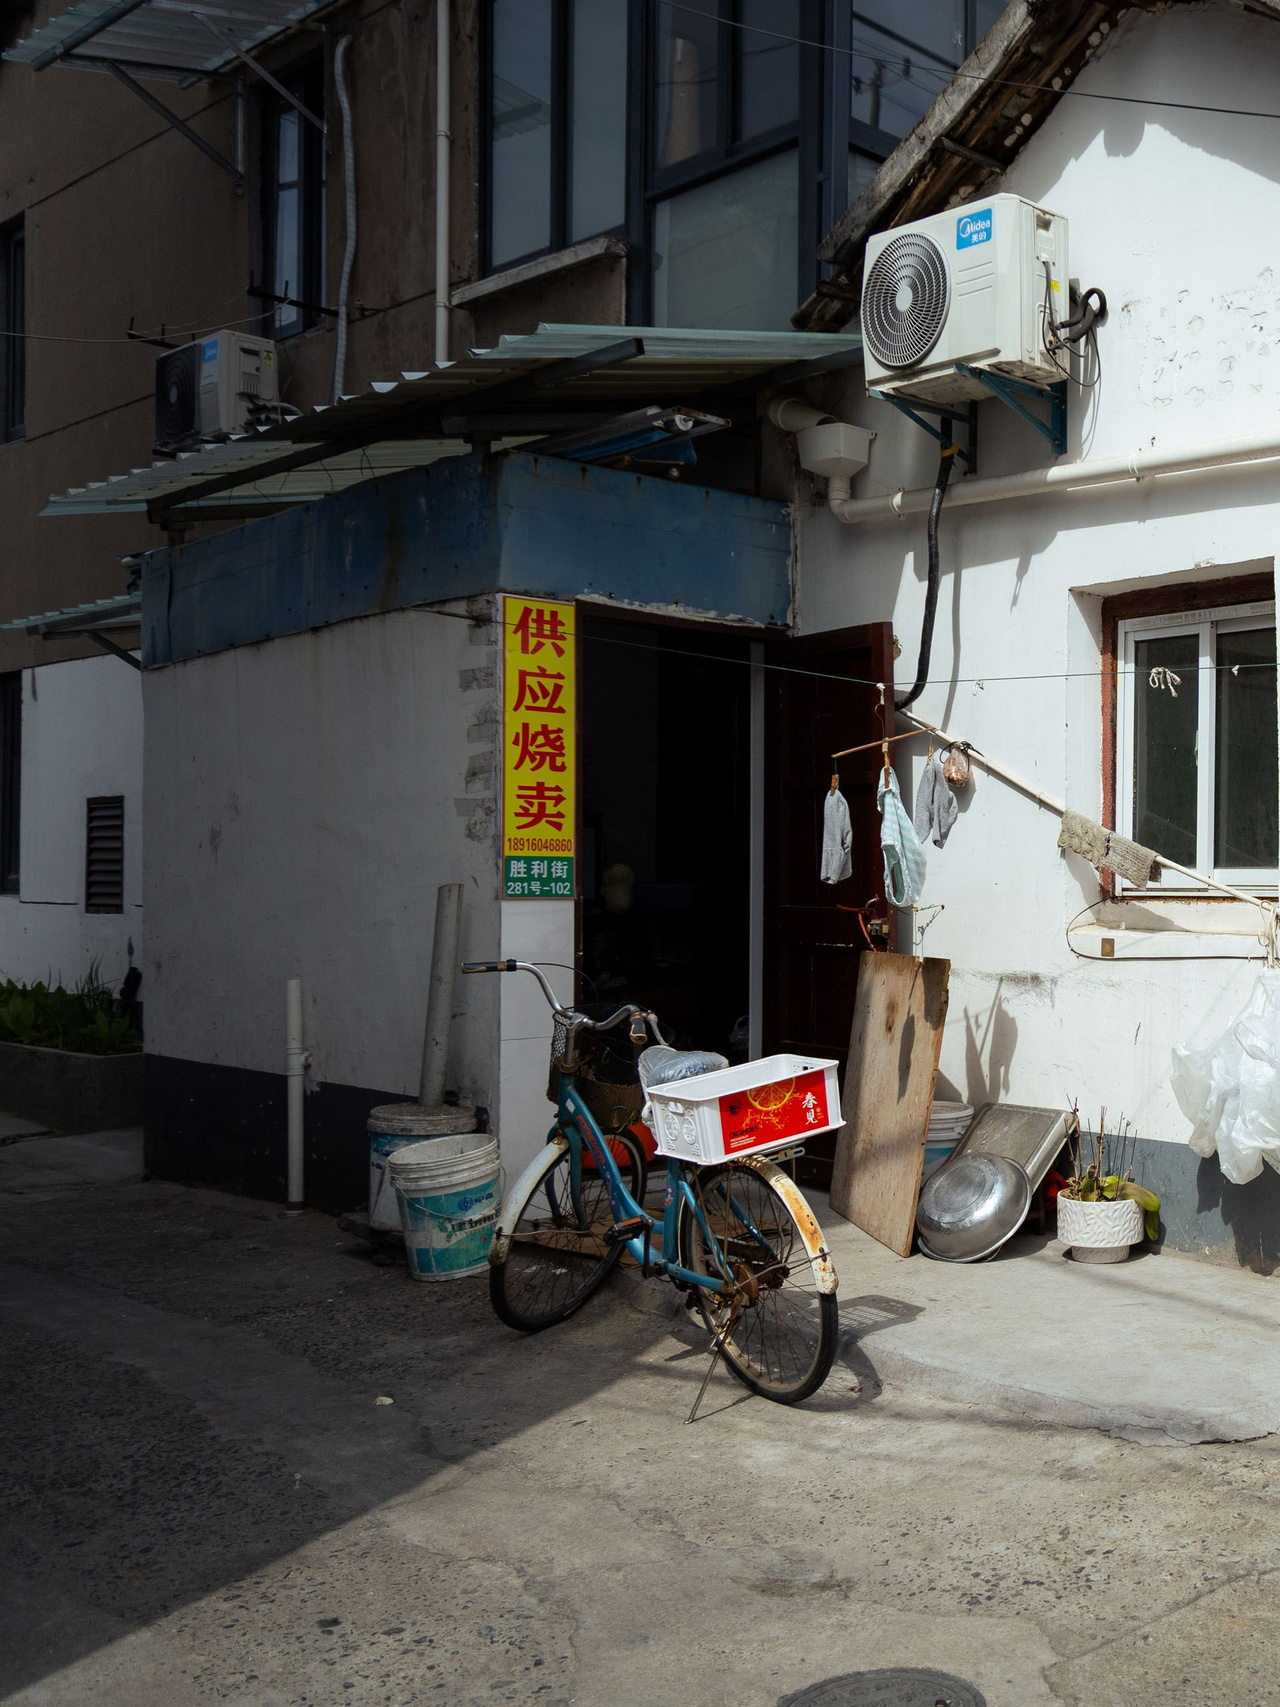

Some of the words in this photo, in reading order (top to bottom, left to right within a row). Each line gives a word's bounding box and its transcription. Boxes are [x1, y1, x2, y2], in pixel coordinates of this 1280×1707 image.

[960, 218, 991, 238] Midea
[971, 231, 987, 243] 美的
[512, 606, 568, 831] 供应烧卖
[507, 837, 572, 852] 18916046860
[509, 860, 569, 878] 胜利街
[507, 881, 571, 895] 281号-102
